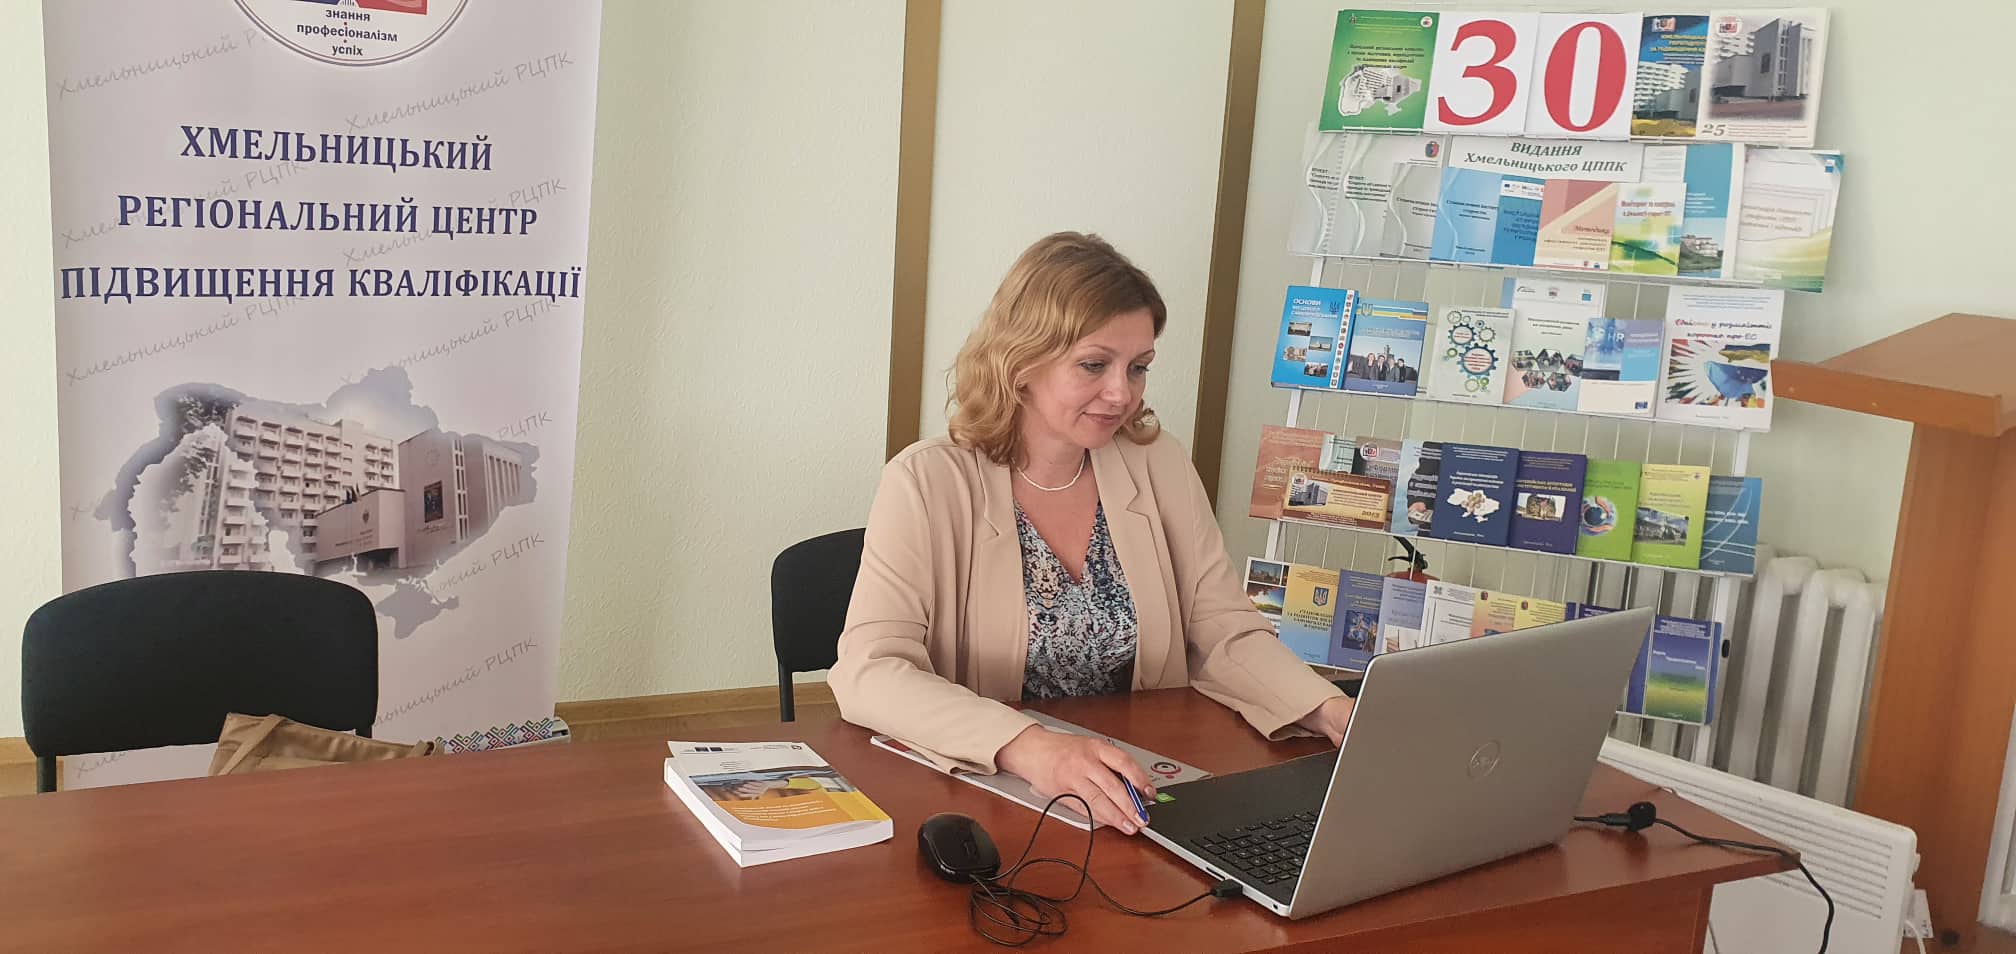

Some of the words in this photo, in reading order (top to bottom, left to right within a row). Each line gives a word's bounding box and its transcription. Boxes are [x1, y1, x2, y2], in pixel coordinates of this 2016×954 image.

[325, 9, 371, 22] знання
[296, 24, 398, 42] професіоналізм
[332, 45, 364, 57] успіх
[514, 50, 575, 82] РЦПК
[1701, 123, 1726, 137] 25
[179, 125, 493, 174] ХМЕЛЬНИЦЬКИЙ
[1464, 152, 1578, 173] Хмельницького
[1582, 160, 1628, 173] ЦППК
[1511, 142, 1583, 158] ВИДАННЯ
[508, 178, 568, 208] РЦПК
[117, 195, 418, 233] РЕГІОНАЛЬНИЙ
[432, 205, 539, 241] ЦЕНТР
[59, 266, 335, 304] ПІДВИЩЕННЯ
[348, 265, 582, 304] КВАЛІФІКАЦІЇ
[490, 532, 545, 568] РЦПК
[484, 634, 538, 674] РЦПК
